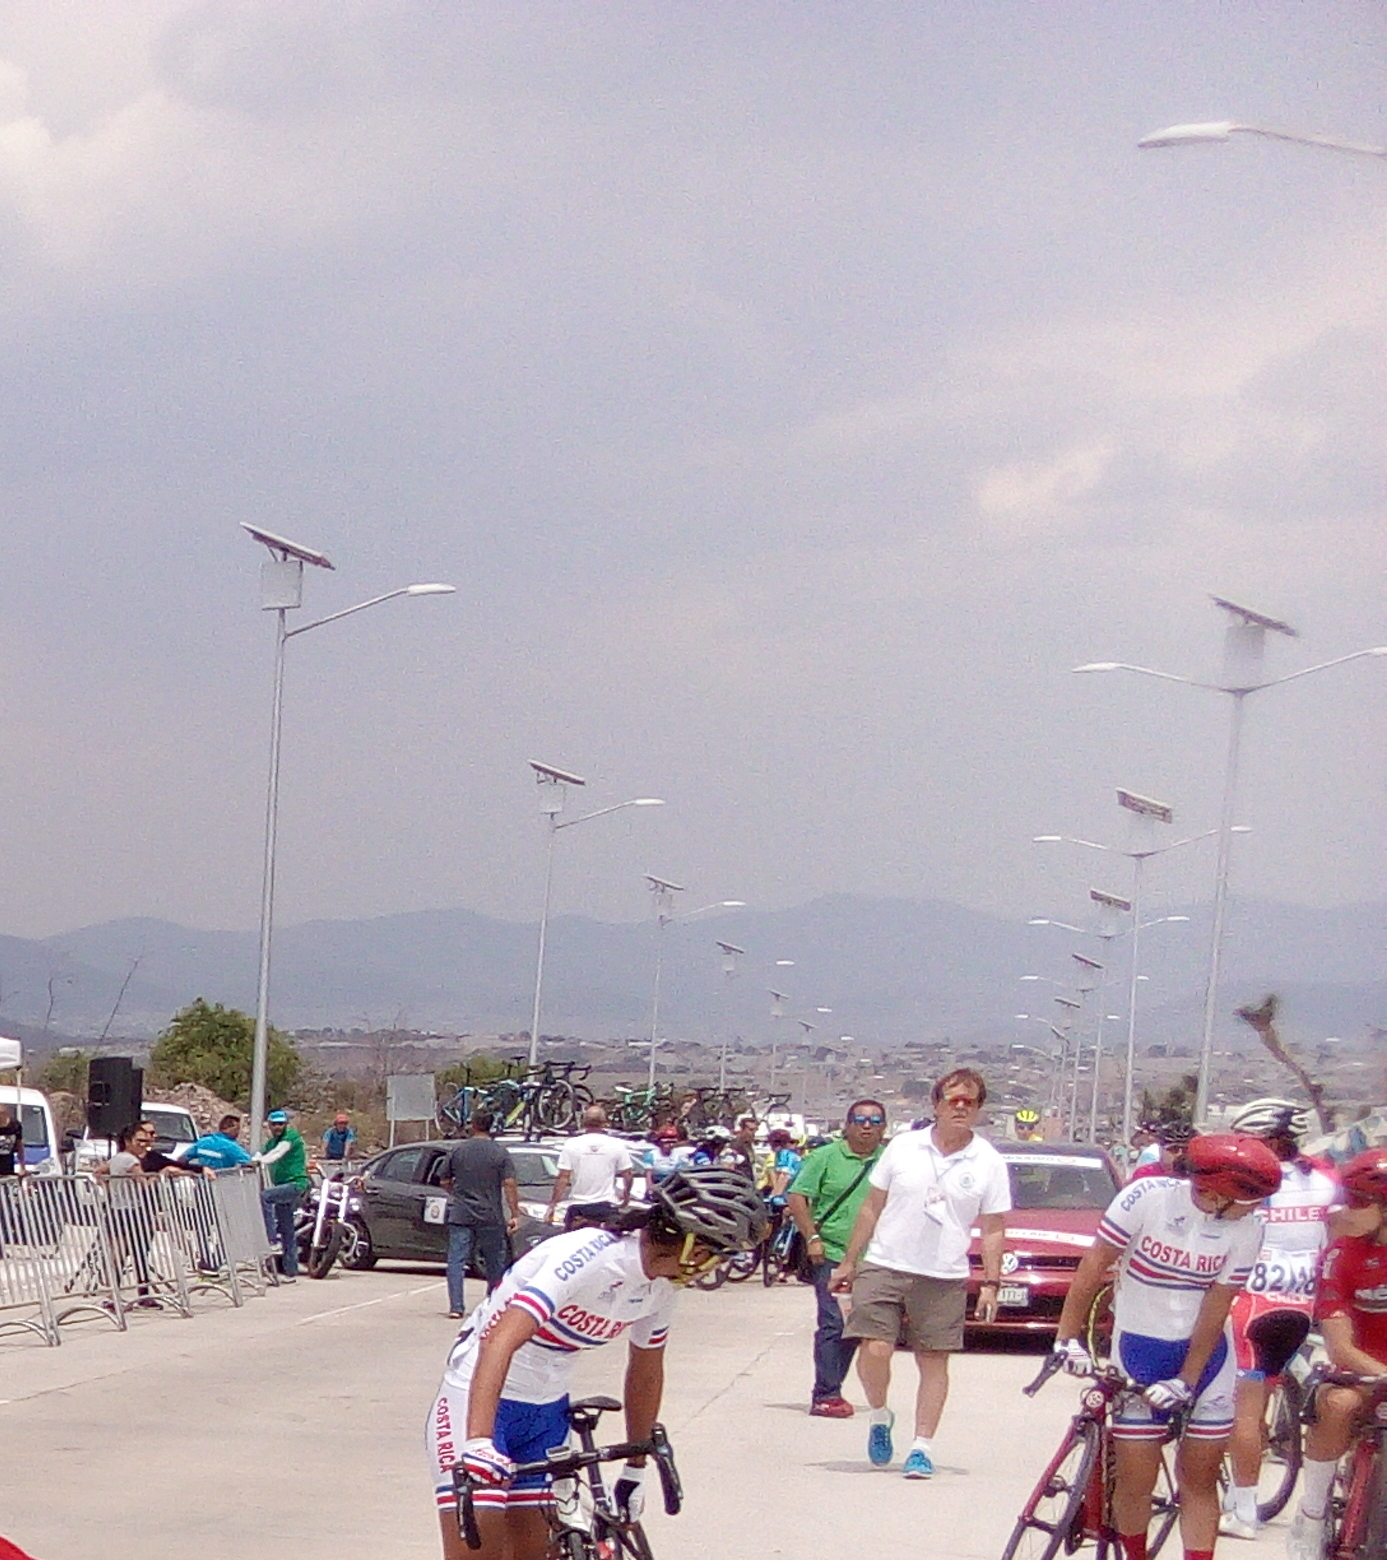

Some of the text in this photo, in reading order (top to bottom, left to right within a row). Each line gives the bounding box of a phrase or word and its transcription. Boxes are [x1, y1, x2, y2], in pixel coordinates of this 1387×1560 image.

[1120, 1179, 1156, 1212] COSTA
[554, 1246, 596, 1281] COSTA
[1141, 1236, 1191, 1269] COSTA
[1250, 1262, 1285, 1292] 82
[435, 1397, 452, 1440] COSTA
[437, 1441, 456, 1474] RICA
